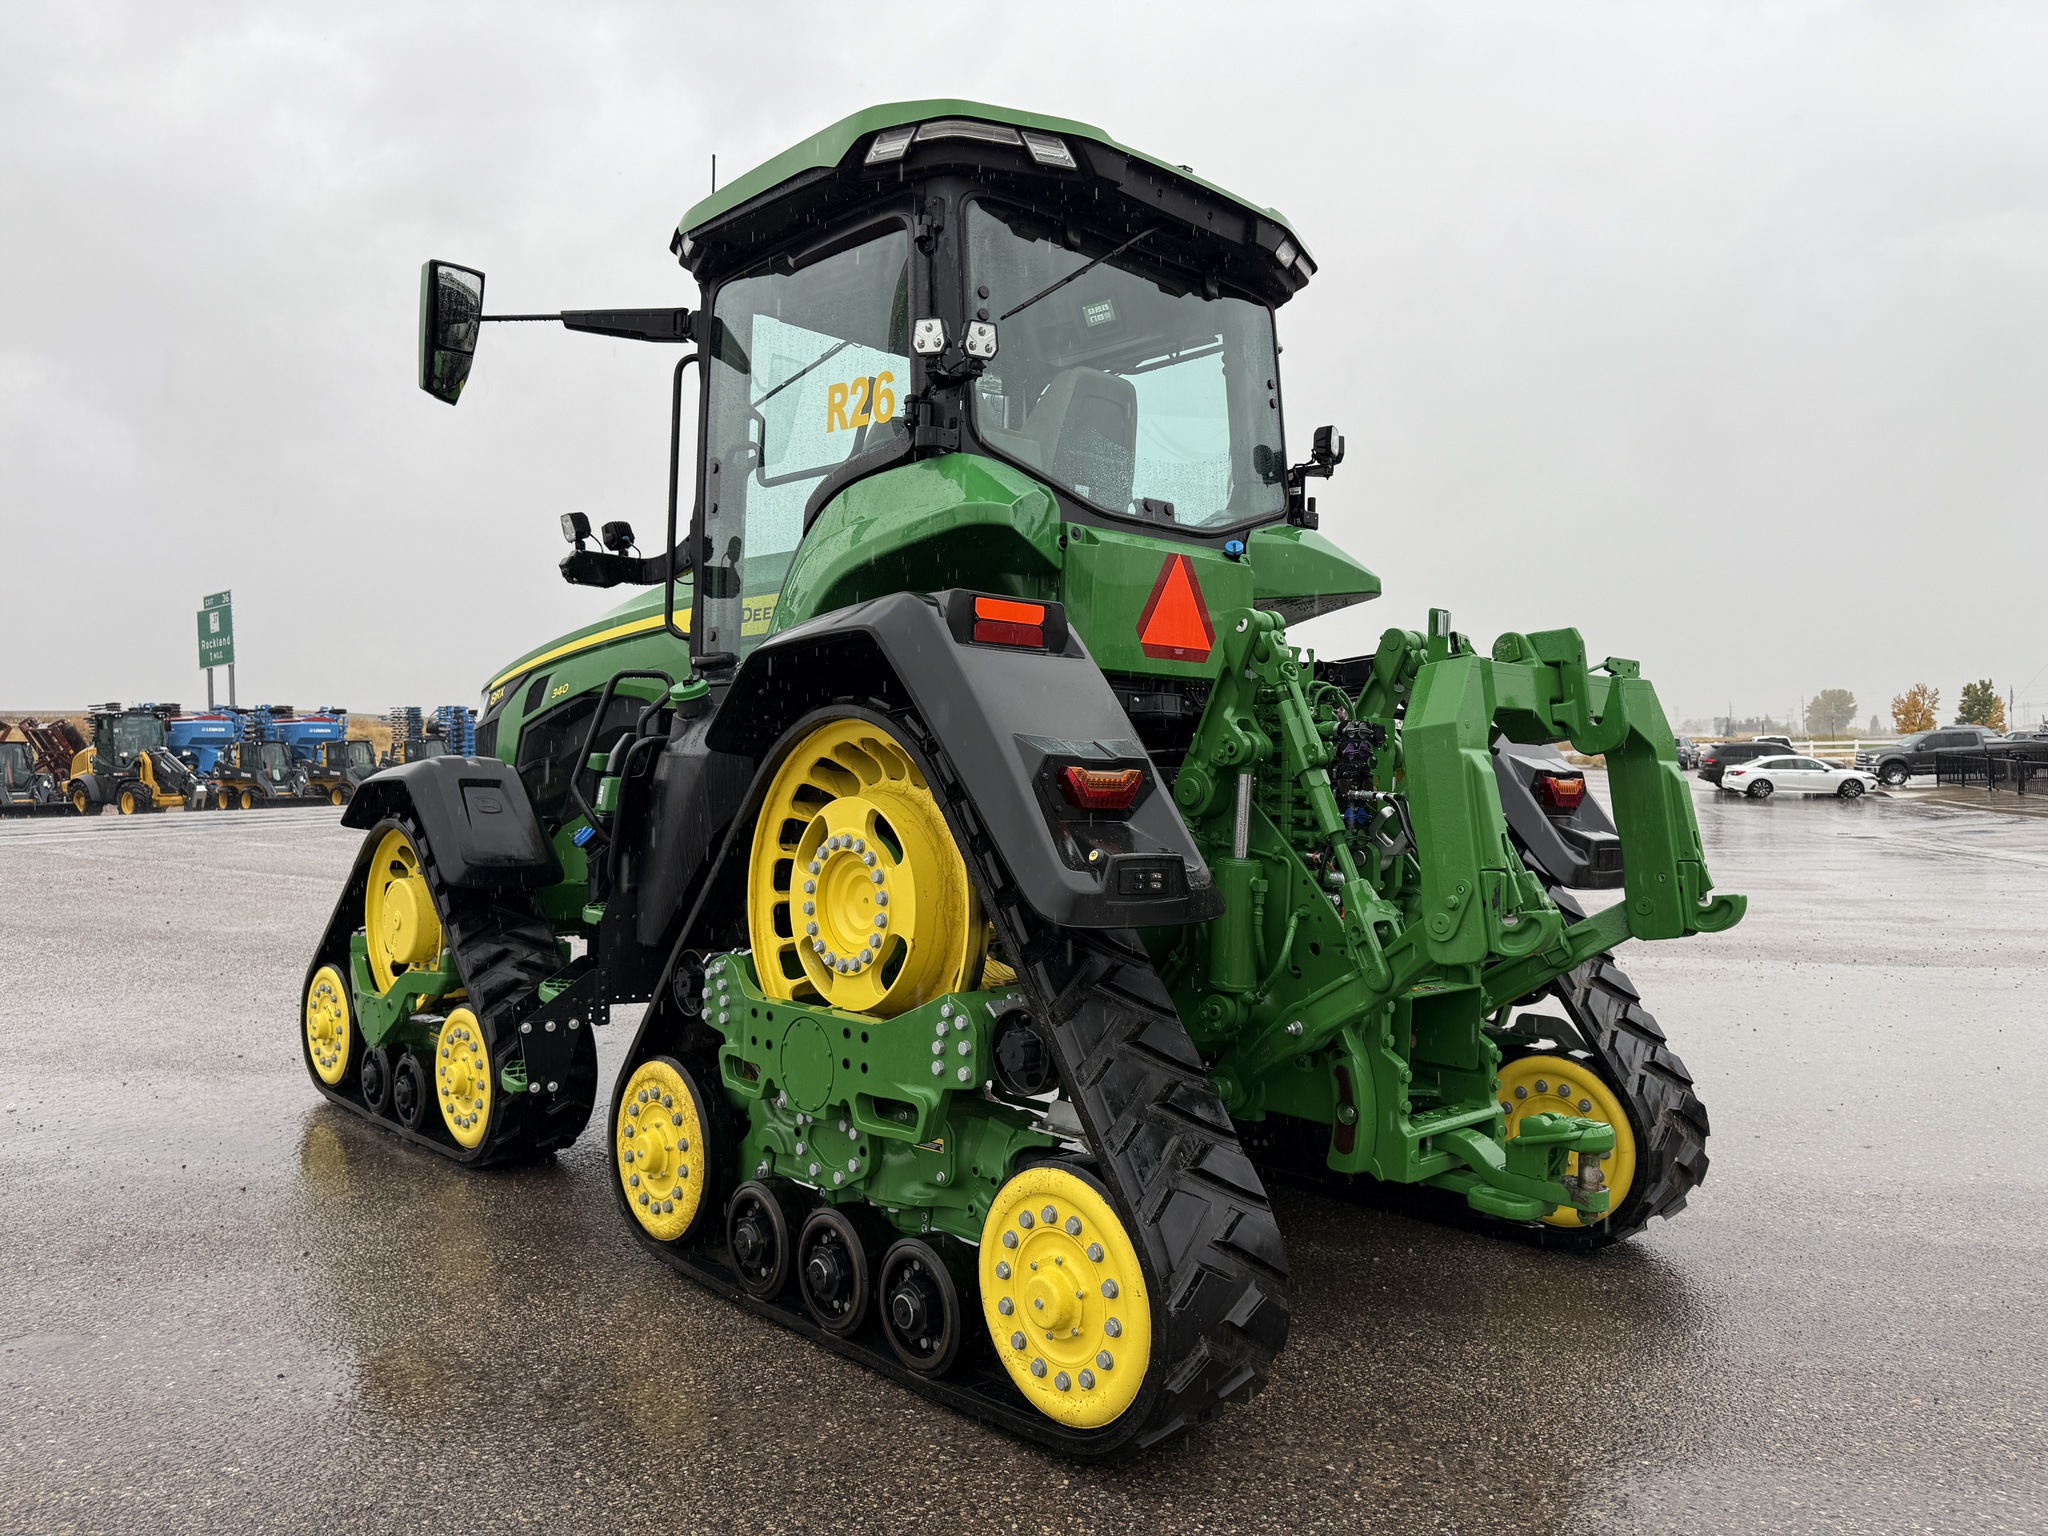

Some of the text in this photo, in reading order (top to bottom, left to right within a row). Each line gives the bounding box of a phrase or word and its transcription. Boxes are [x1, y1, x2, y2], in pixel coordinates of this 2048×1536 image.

[826, 370, 895, 433] R26
[222, 592, 230, 604] 36
[741, 606, 774, 623] DEE
[202, 635, 230, 650] Rockland
[551, 682, 569, 699] 340
